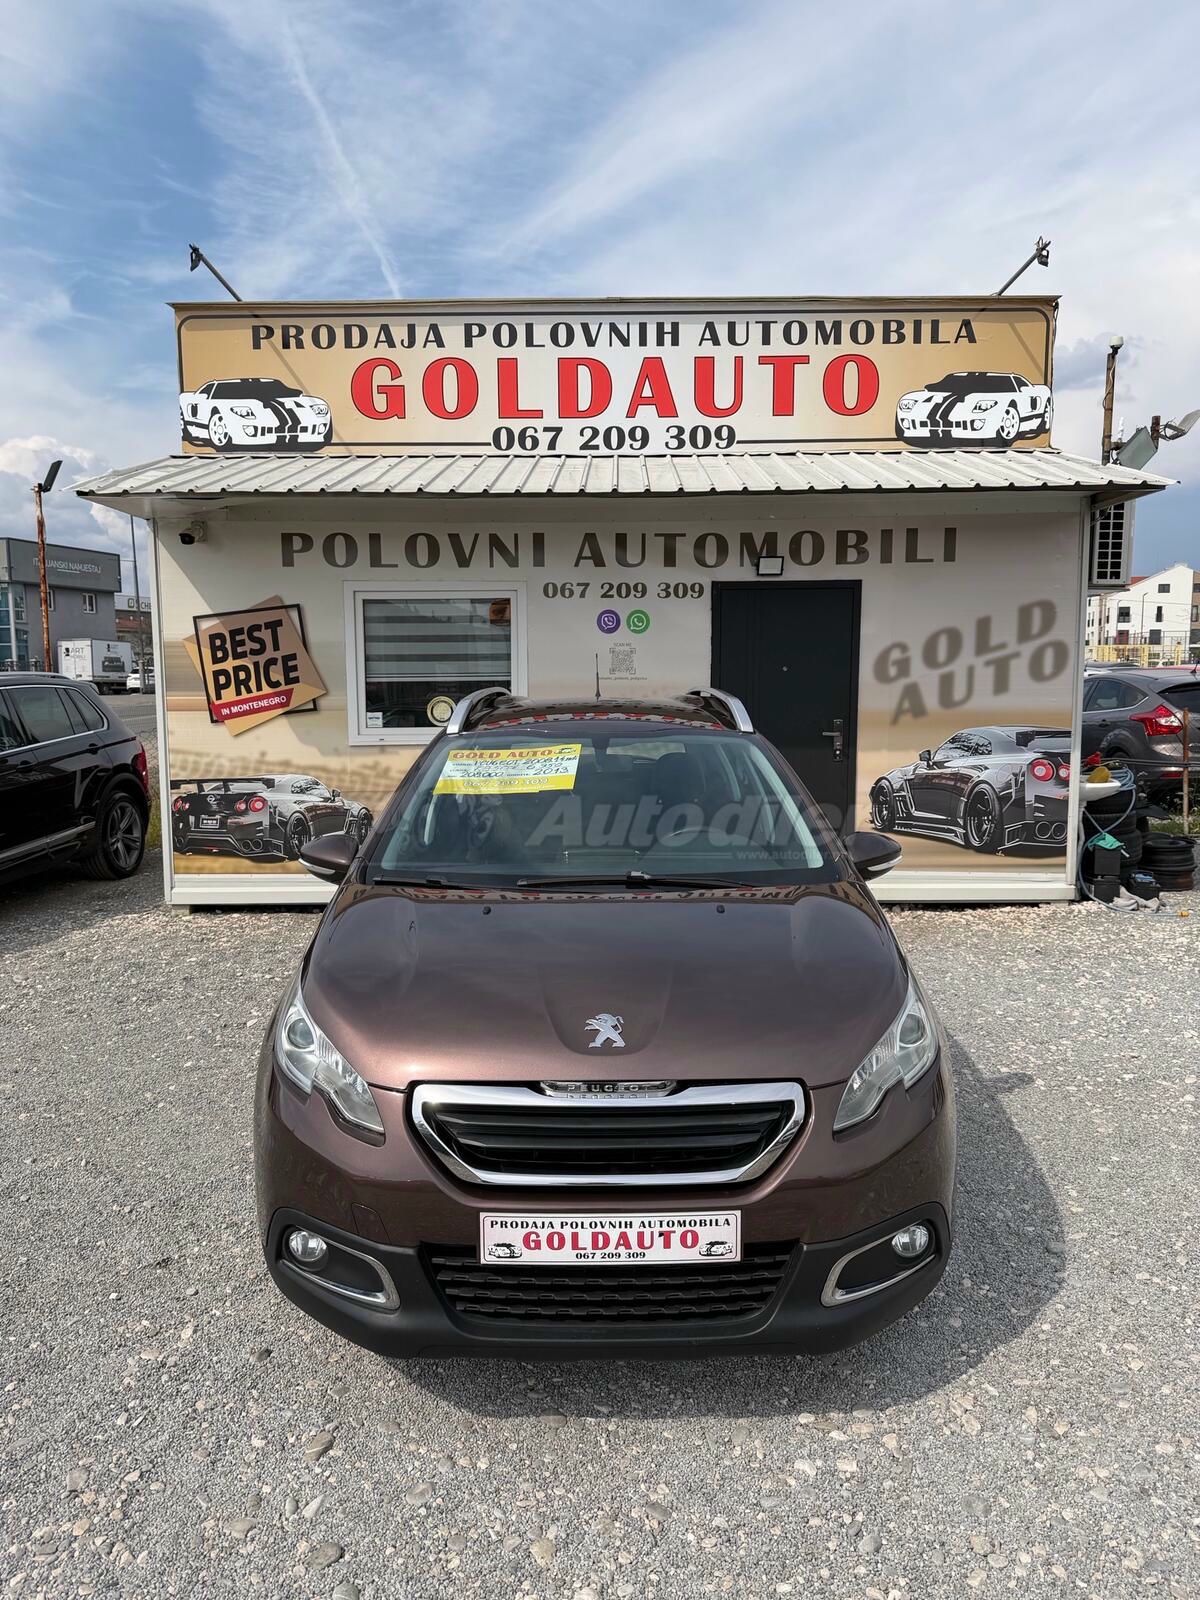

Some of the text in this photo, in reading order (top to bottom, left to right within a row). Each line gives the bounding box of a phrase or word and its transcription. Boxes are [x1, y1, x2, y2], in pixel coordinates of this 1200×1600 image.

[252, 318, 977, 350] PRODAJA POLOVNIH AUTOMOBILA
[351, 354, 880, 420] GOLDAUTO
[492, 424, 736, 452] 067 209 309
[281, 527, 957, 569] POLOVNI AUTOMOBILI
[543, 582, 705, 599] 067 209 309
[208, 619, 283, 665] BEST
[873, 599, 1057, 684] GOLD
[212, 652, 300, 701] PRICE
[890, 639, 1070, 725] AUTO
[221, 695, 287, 716] IN MONTENEGRO
[506, 749, 553, 758] AUTO
[490, 1217, 731, 1230] PRODAJA POLOVNIH AUTOMOBILA
[522, 1229, 700, 1251] GOLDAUTO
[575, 1251, 646, 1260] 067 209 309
